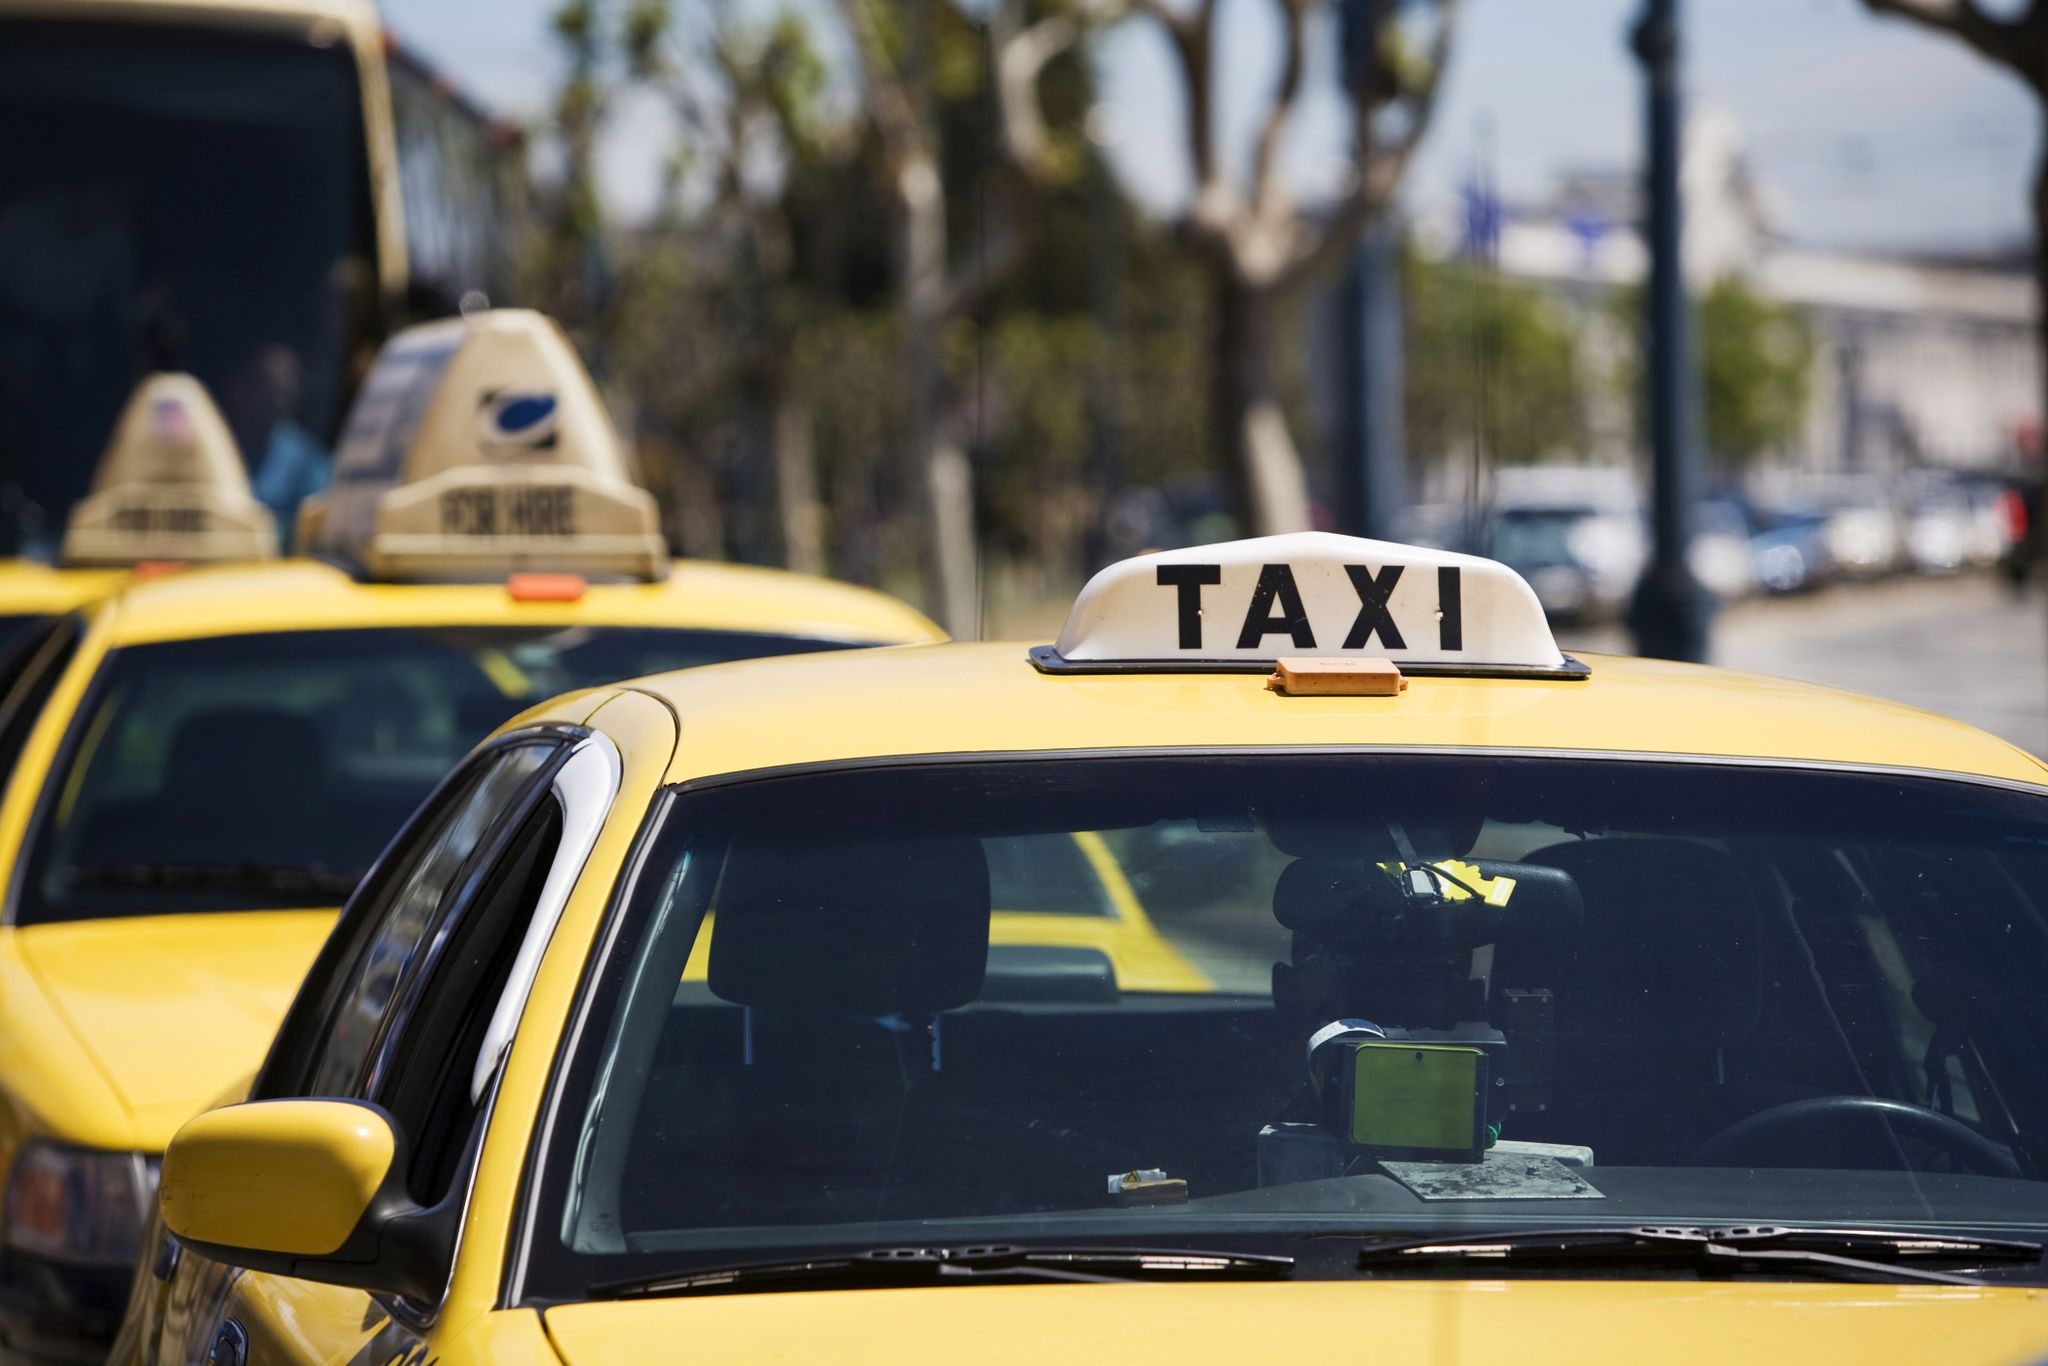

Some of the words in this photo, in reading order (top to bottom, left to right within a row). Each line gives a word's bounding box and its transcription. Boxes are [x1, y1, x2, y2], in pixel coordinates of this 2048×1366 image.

[442, 487, 495, 534] FOR
[509, 485, 576, 534] HIRE
[1157, 564, 1463, 651] TAXI
